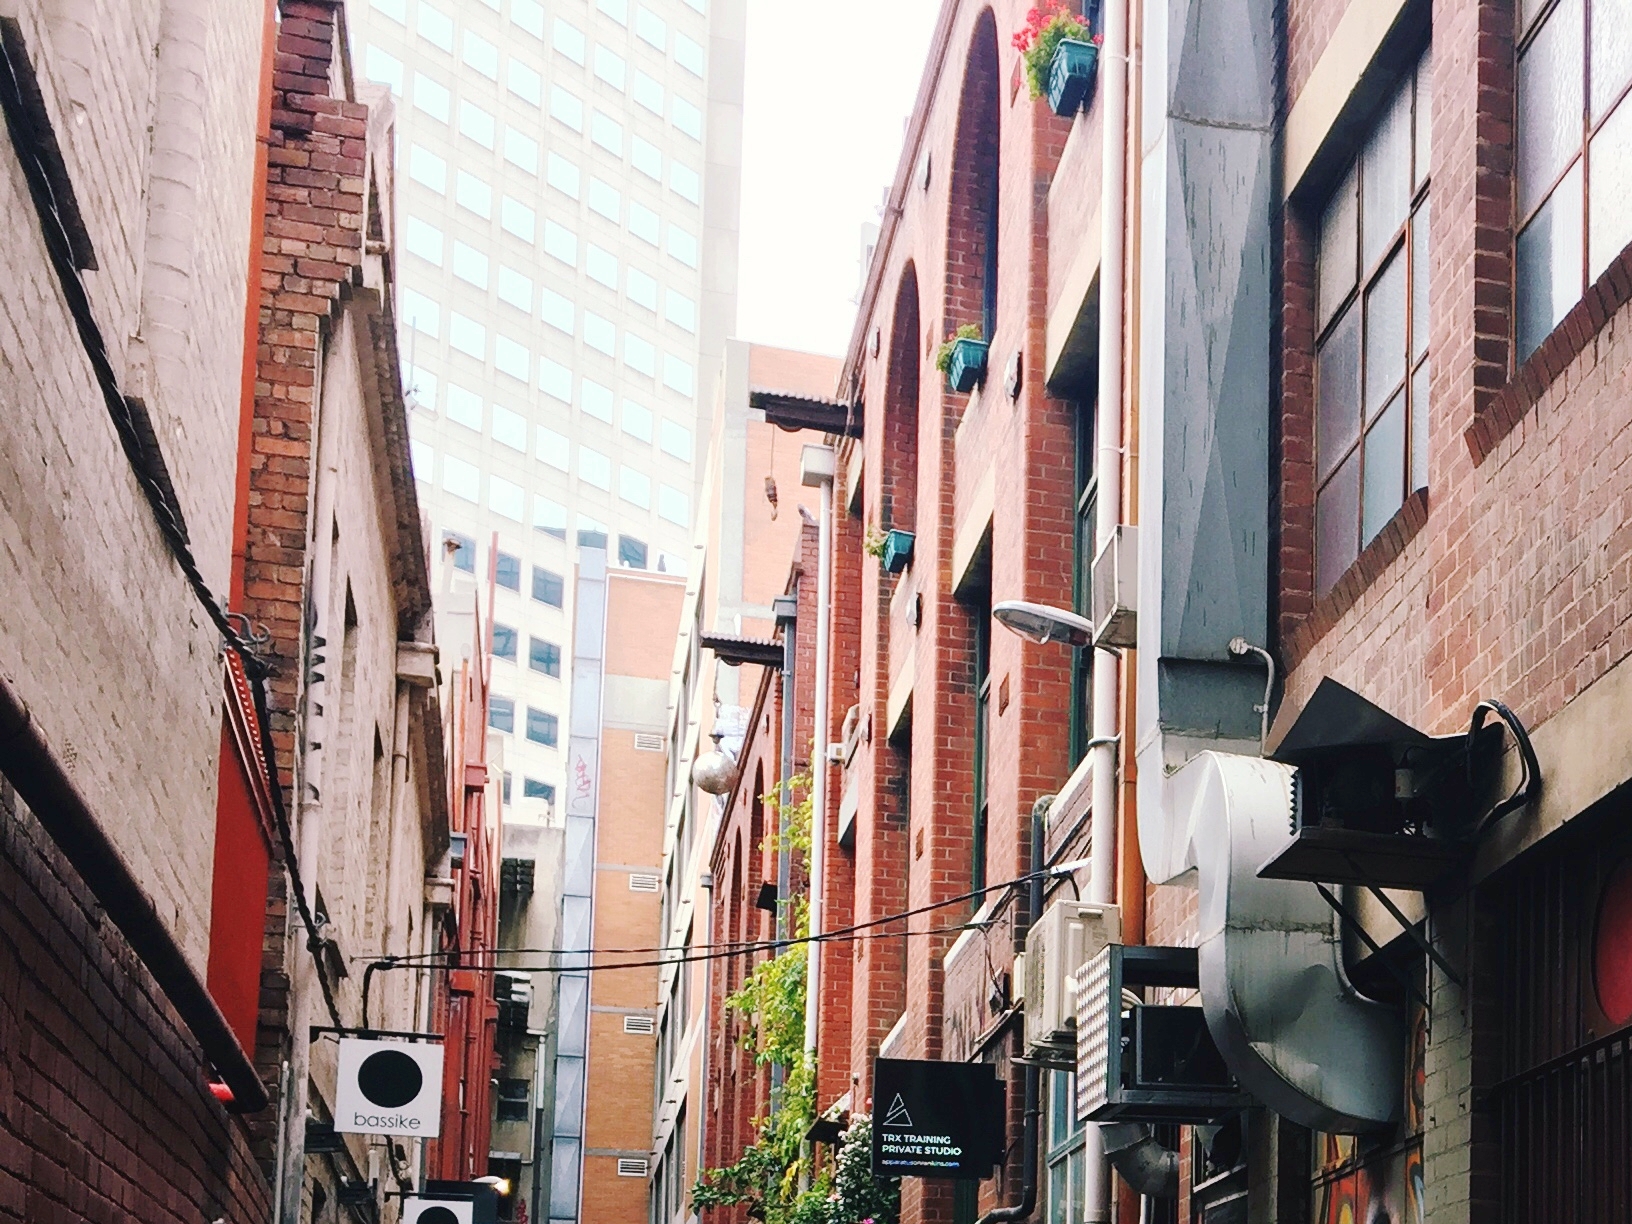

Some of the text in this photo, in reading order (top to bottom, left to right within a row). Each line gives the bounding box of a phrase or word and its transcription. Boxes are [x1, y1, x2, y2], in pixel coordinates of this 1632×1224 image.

[353, 1112, 421, 1129] bassike
[881, 1133, 951, 1145] TRX TRAINING
[881, 1145, 963, 1156] PRIVATE STUDIO
